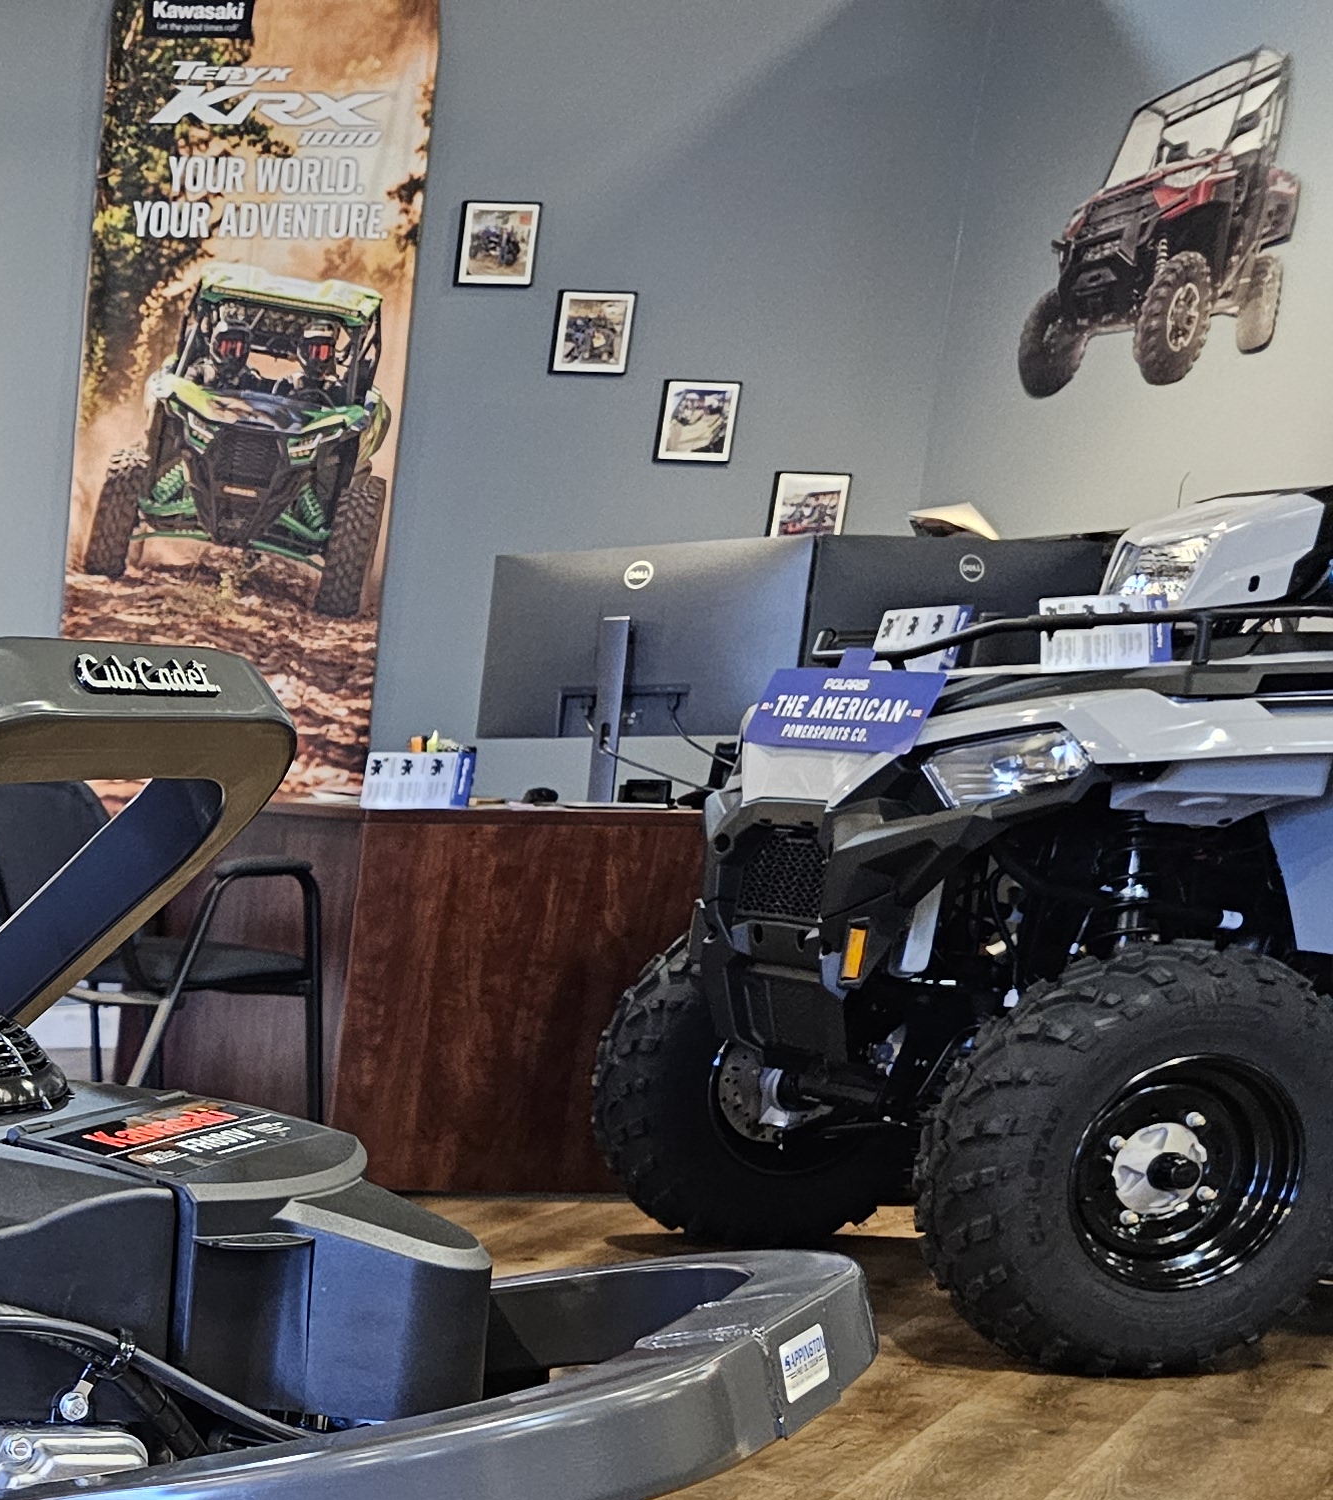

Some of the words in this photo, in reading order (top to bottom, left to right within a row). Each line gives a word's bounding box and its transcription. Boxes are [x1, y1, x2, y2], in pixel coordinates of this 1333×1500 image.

[152, 1, 245, 20] Kawasaki
[148, 84, 385, 127] KRX
[298, 129, 382, 148] 1000
[168, 155, 247, 195] YOUR
[255, 156, 365, 196] WORLD.
[133, 200, 212, 239] YOUR
[218, 202, 389, 240] ADVENTURE.
[77, 653, 136, 690] Cub
[823, 677, 871, 691] POLARIS
[772, 694, 809, 718] THE
[806, 697, 909, 723] AMERICAN
[780, 723, 850, 741] POWERSPORTS
[850, 727, 867, 742] CO.
[81, 1107, 240, 1148] Kawasaki
